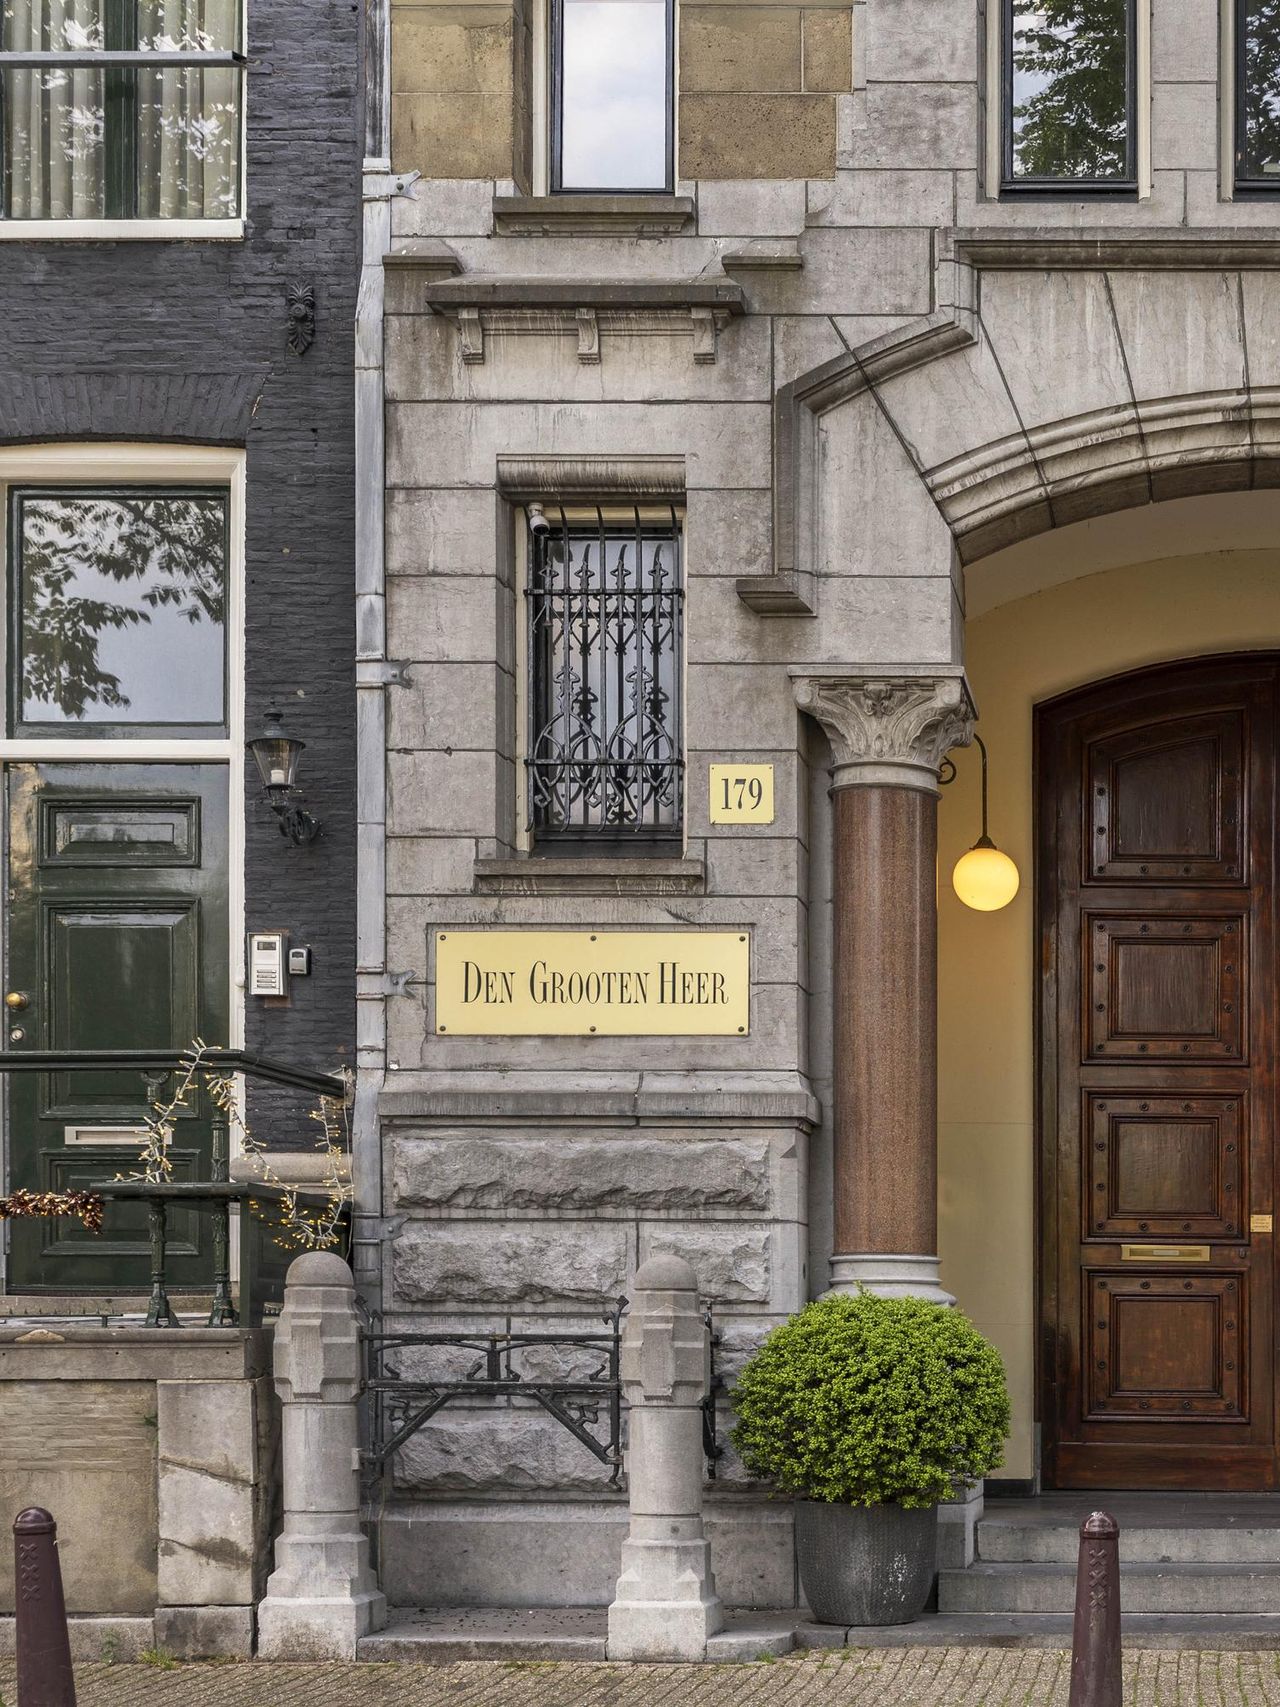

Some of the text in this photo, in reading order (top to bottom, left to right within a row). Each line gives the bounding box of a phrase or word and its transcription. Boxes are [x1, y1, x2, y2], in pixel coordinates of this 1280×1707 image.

[720, 777, 763, 810] 179
[462, 960, 727, 1005] DEN GROOTEN HEER
